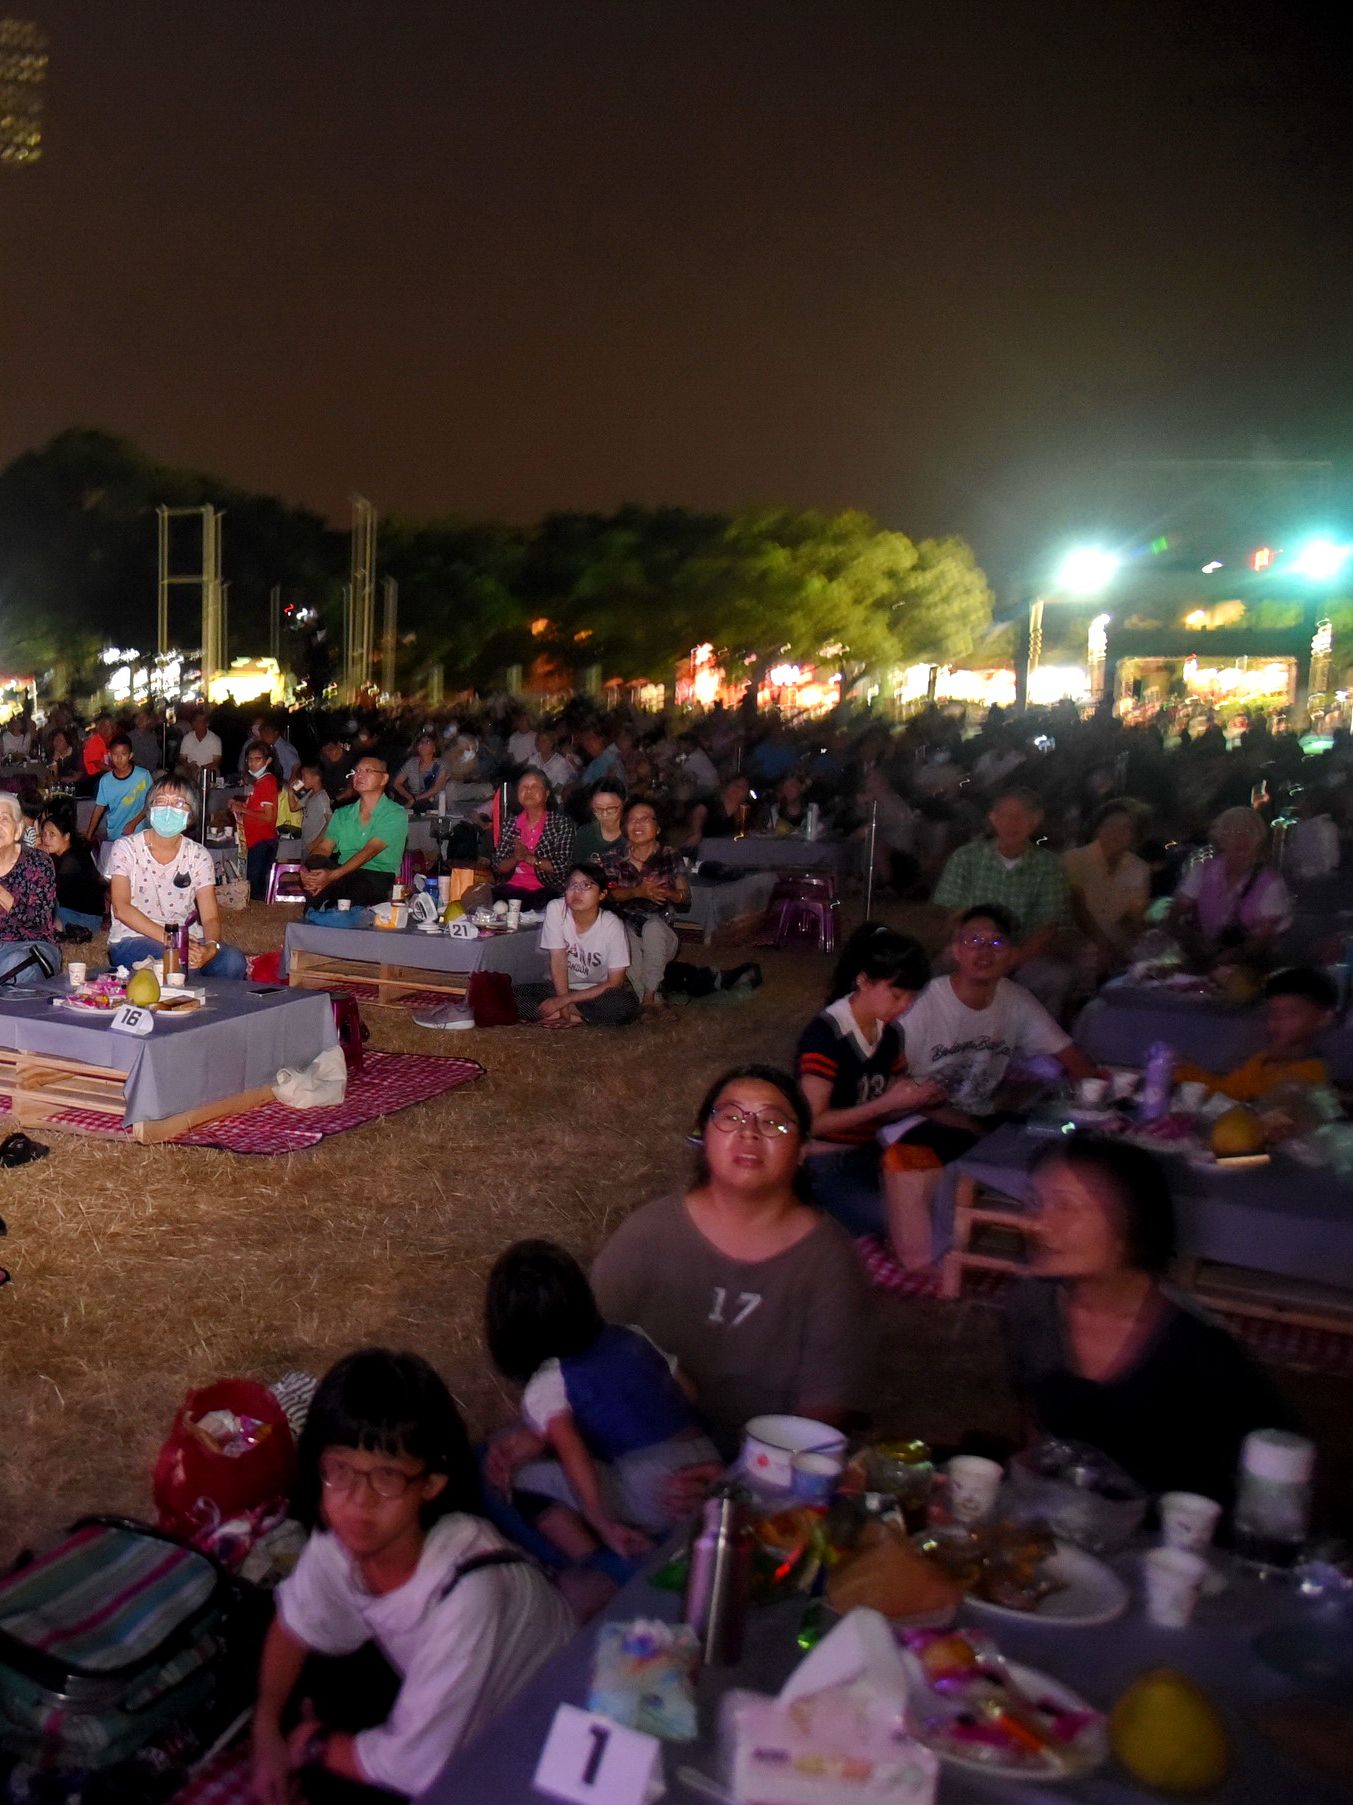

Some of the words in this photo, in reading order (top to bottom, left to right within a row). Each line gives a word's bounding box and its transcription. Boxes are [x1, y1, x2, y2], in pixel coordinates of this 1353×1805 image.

[452, 924, 468, 937] 21
[121, 1008, 142, 1027] 16
[707, 1286, 763, 1327] 17
[582, 1724, 611, 1786] 1
